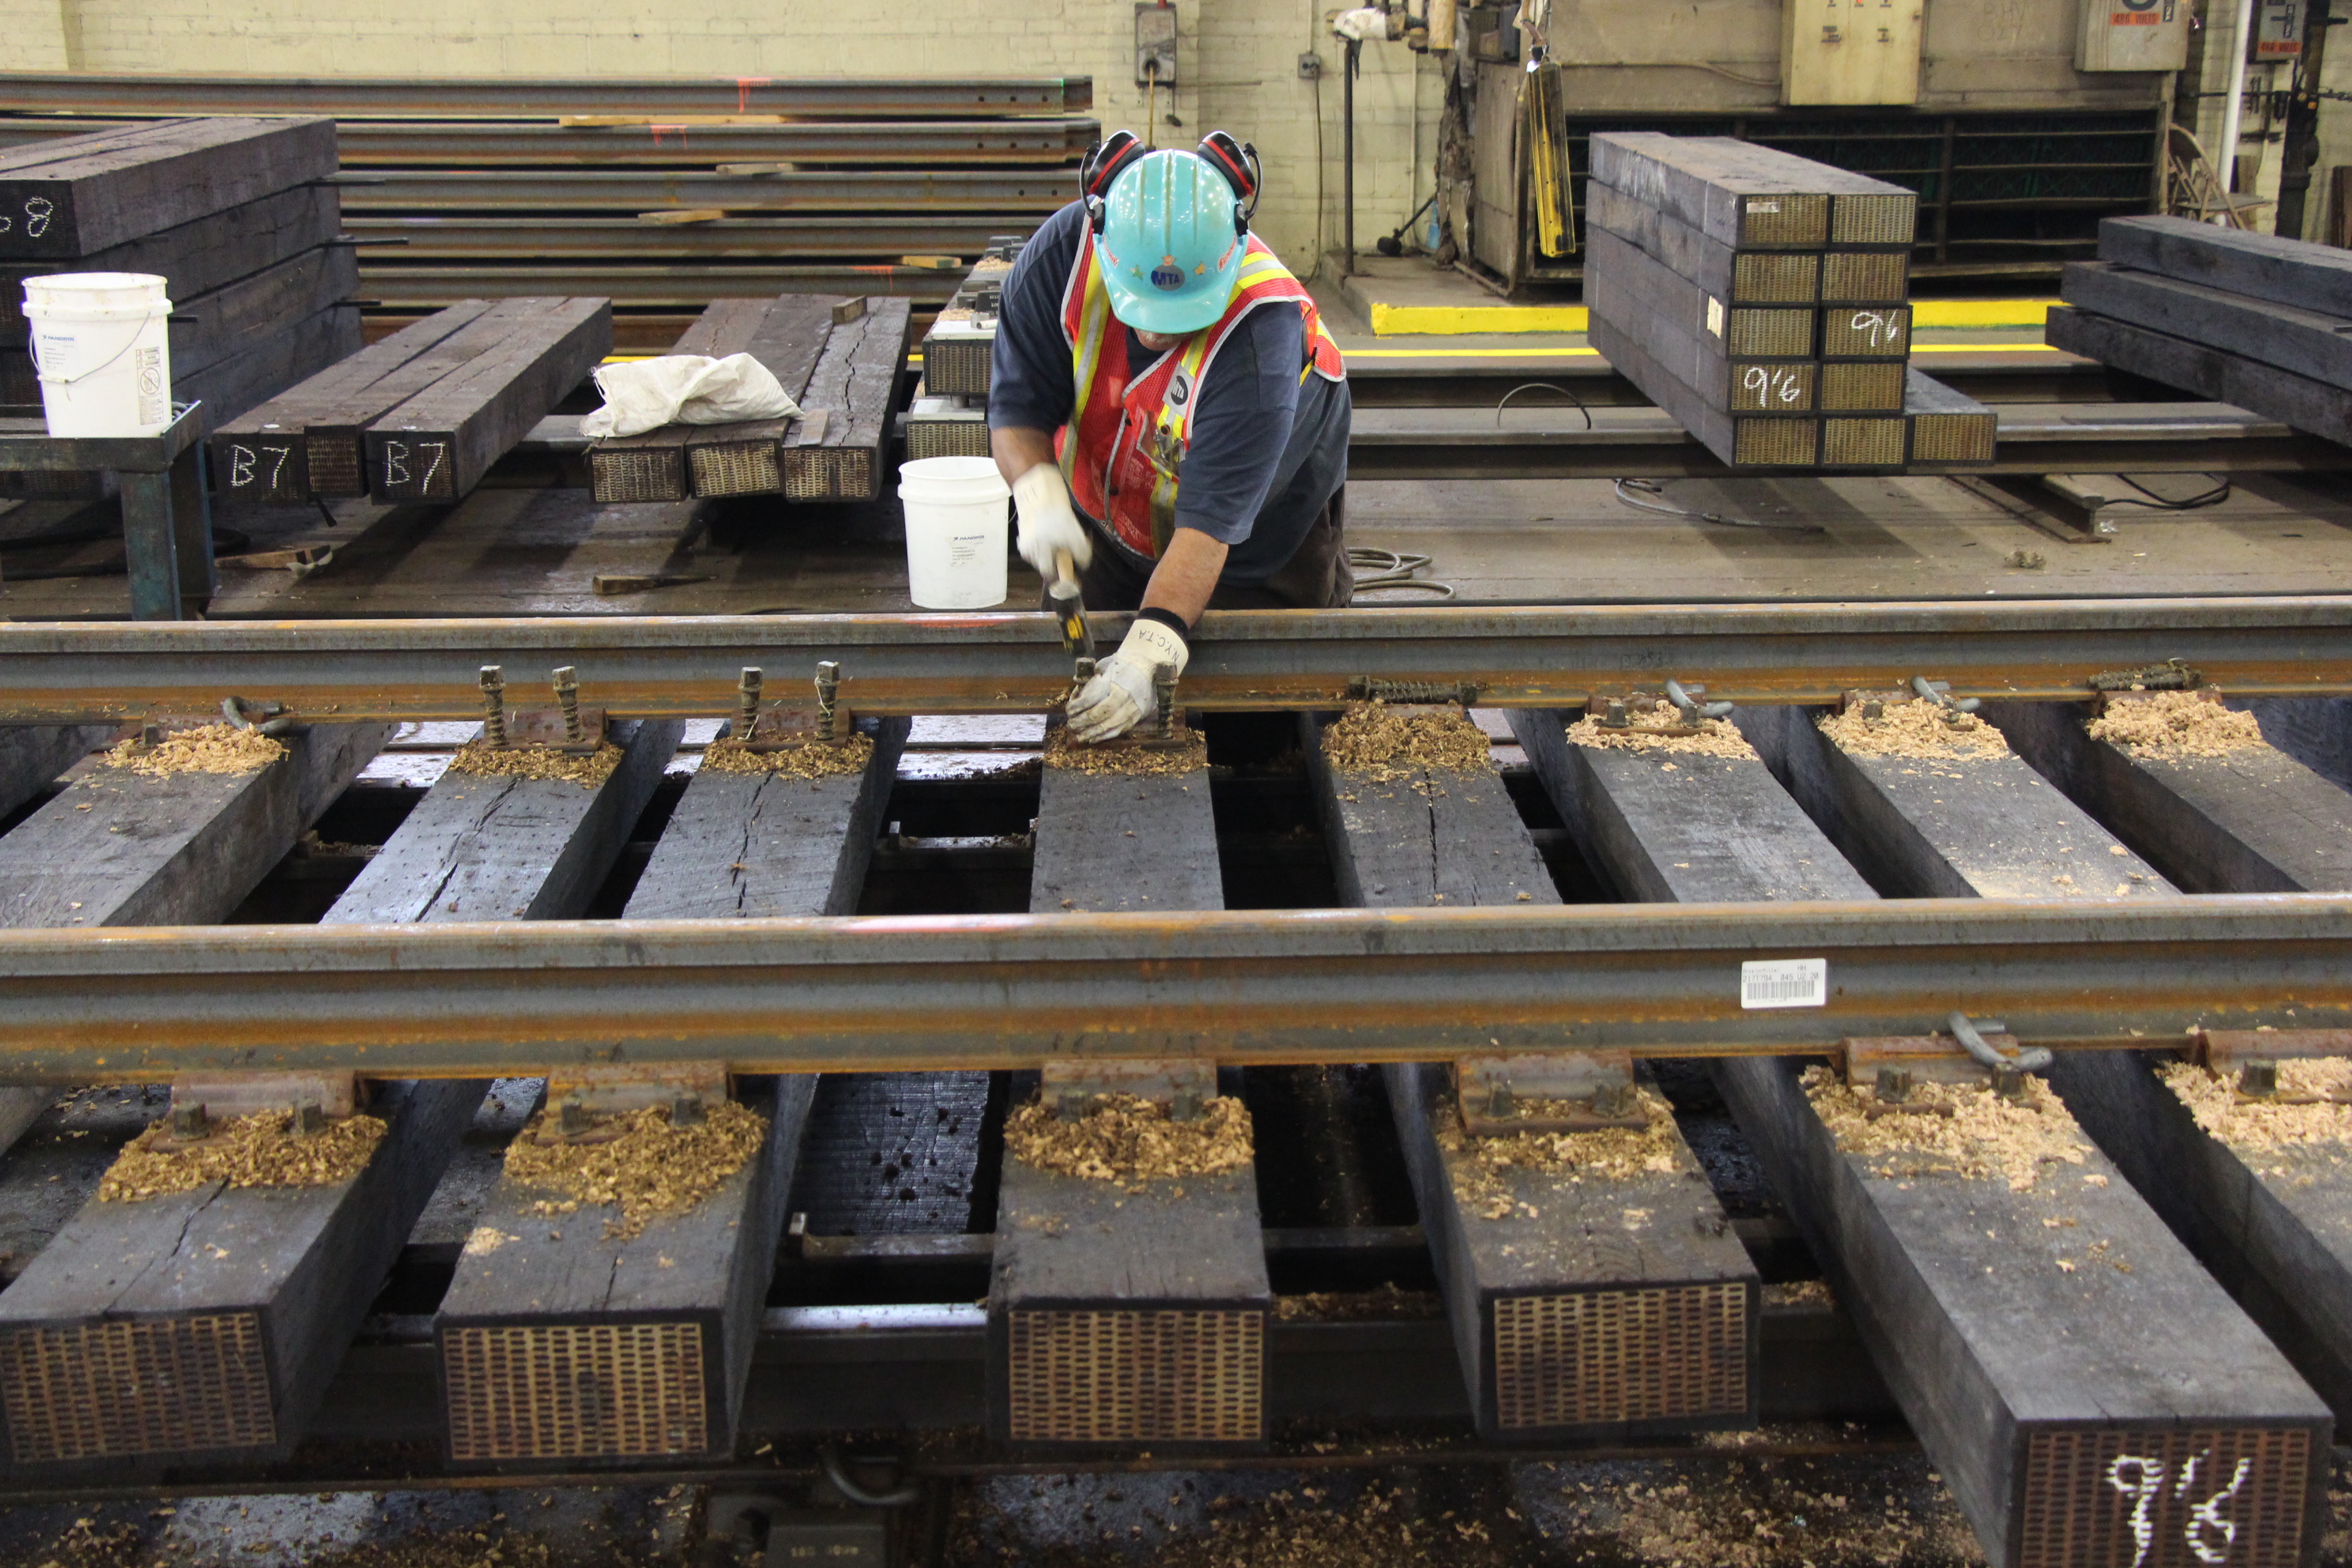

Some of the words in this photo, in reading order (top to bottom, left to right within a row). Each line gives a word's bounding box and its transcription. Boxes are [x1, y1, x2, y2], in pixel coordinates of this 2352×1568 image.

[2136, 13, 2157, 24] VOLTS
[1151, 270, 1180, 286] MTA
[1171, 380, 1185, 400] MTA
